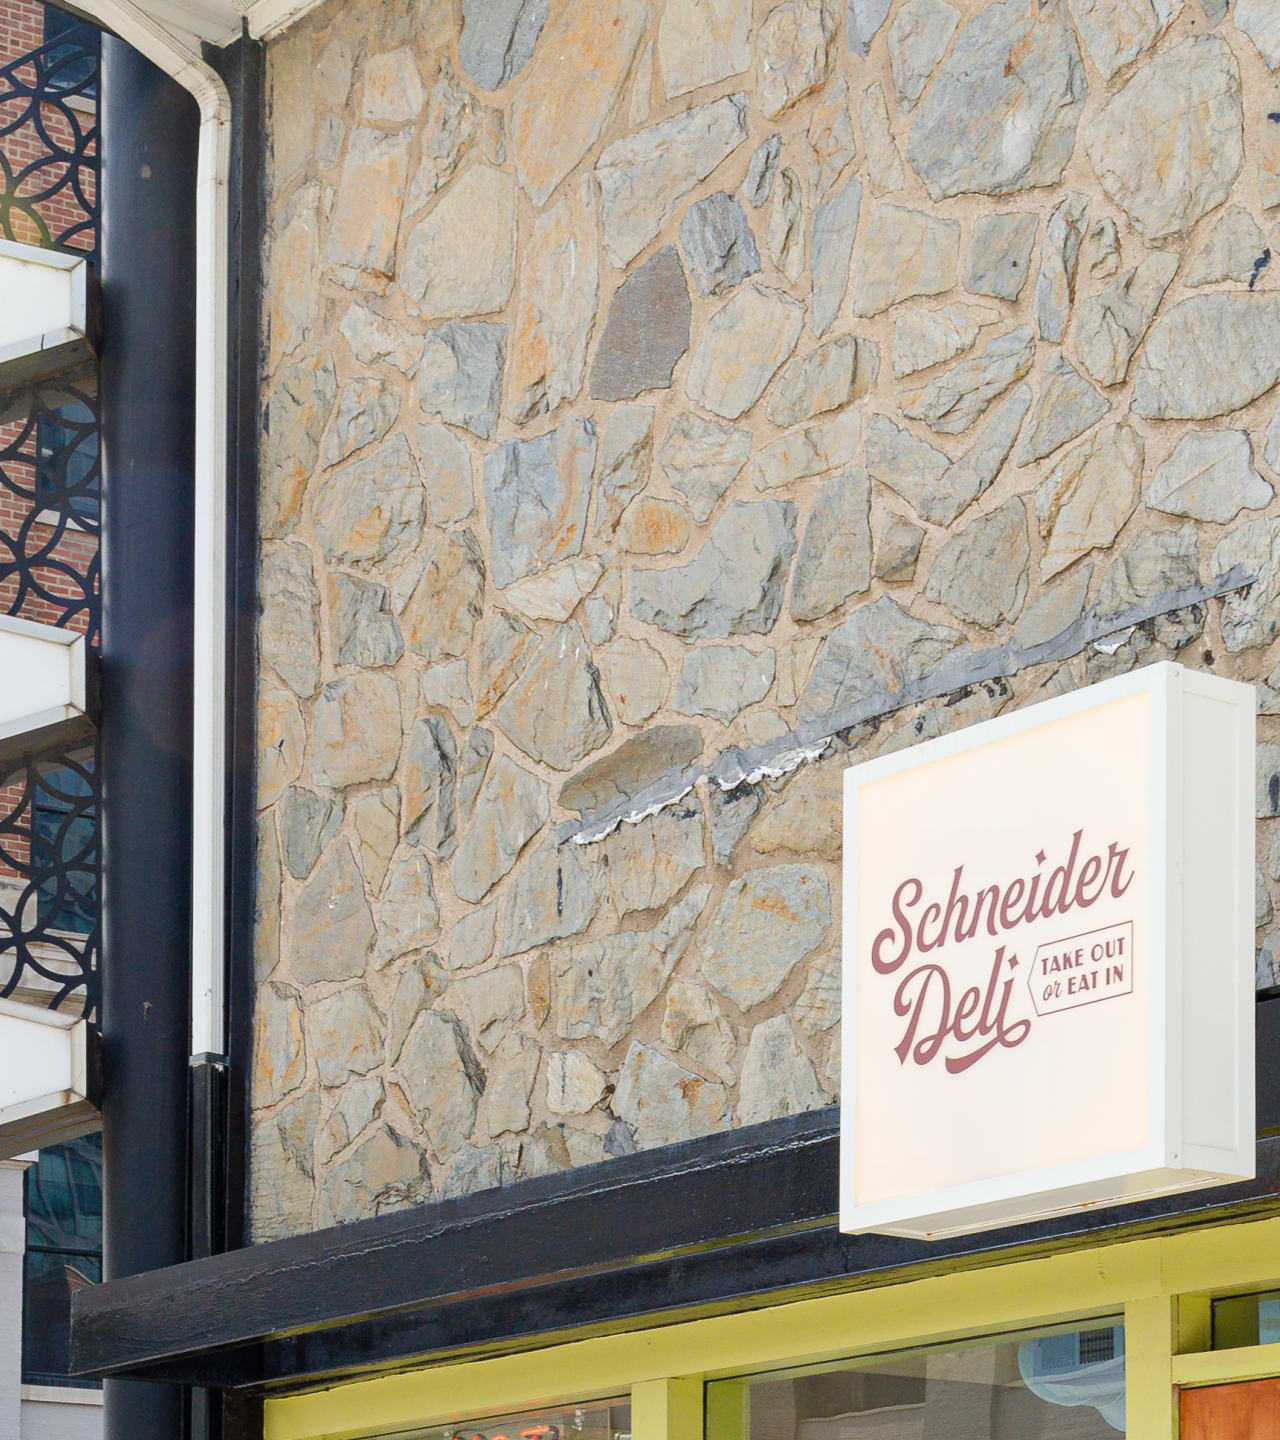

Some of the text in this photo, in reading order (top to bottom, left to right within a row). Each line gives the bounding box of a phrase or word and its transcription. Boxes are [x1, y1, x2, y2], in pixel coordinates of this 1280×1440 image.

[871, 828, 1136, 975] Schneider
[1041, 937, 1125, 976] TAKE OUT
[1042, 963, 1124, 1002] or EAT IN
[893, 944, 1032, 1075] Deli
